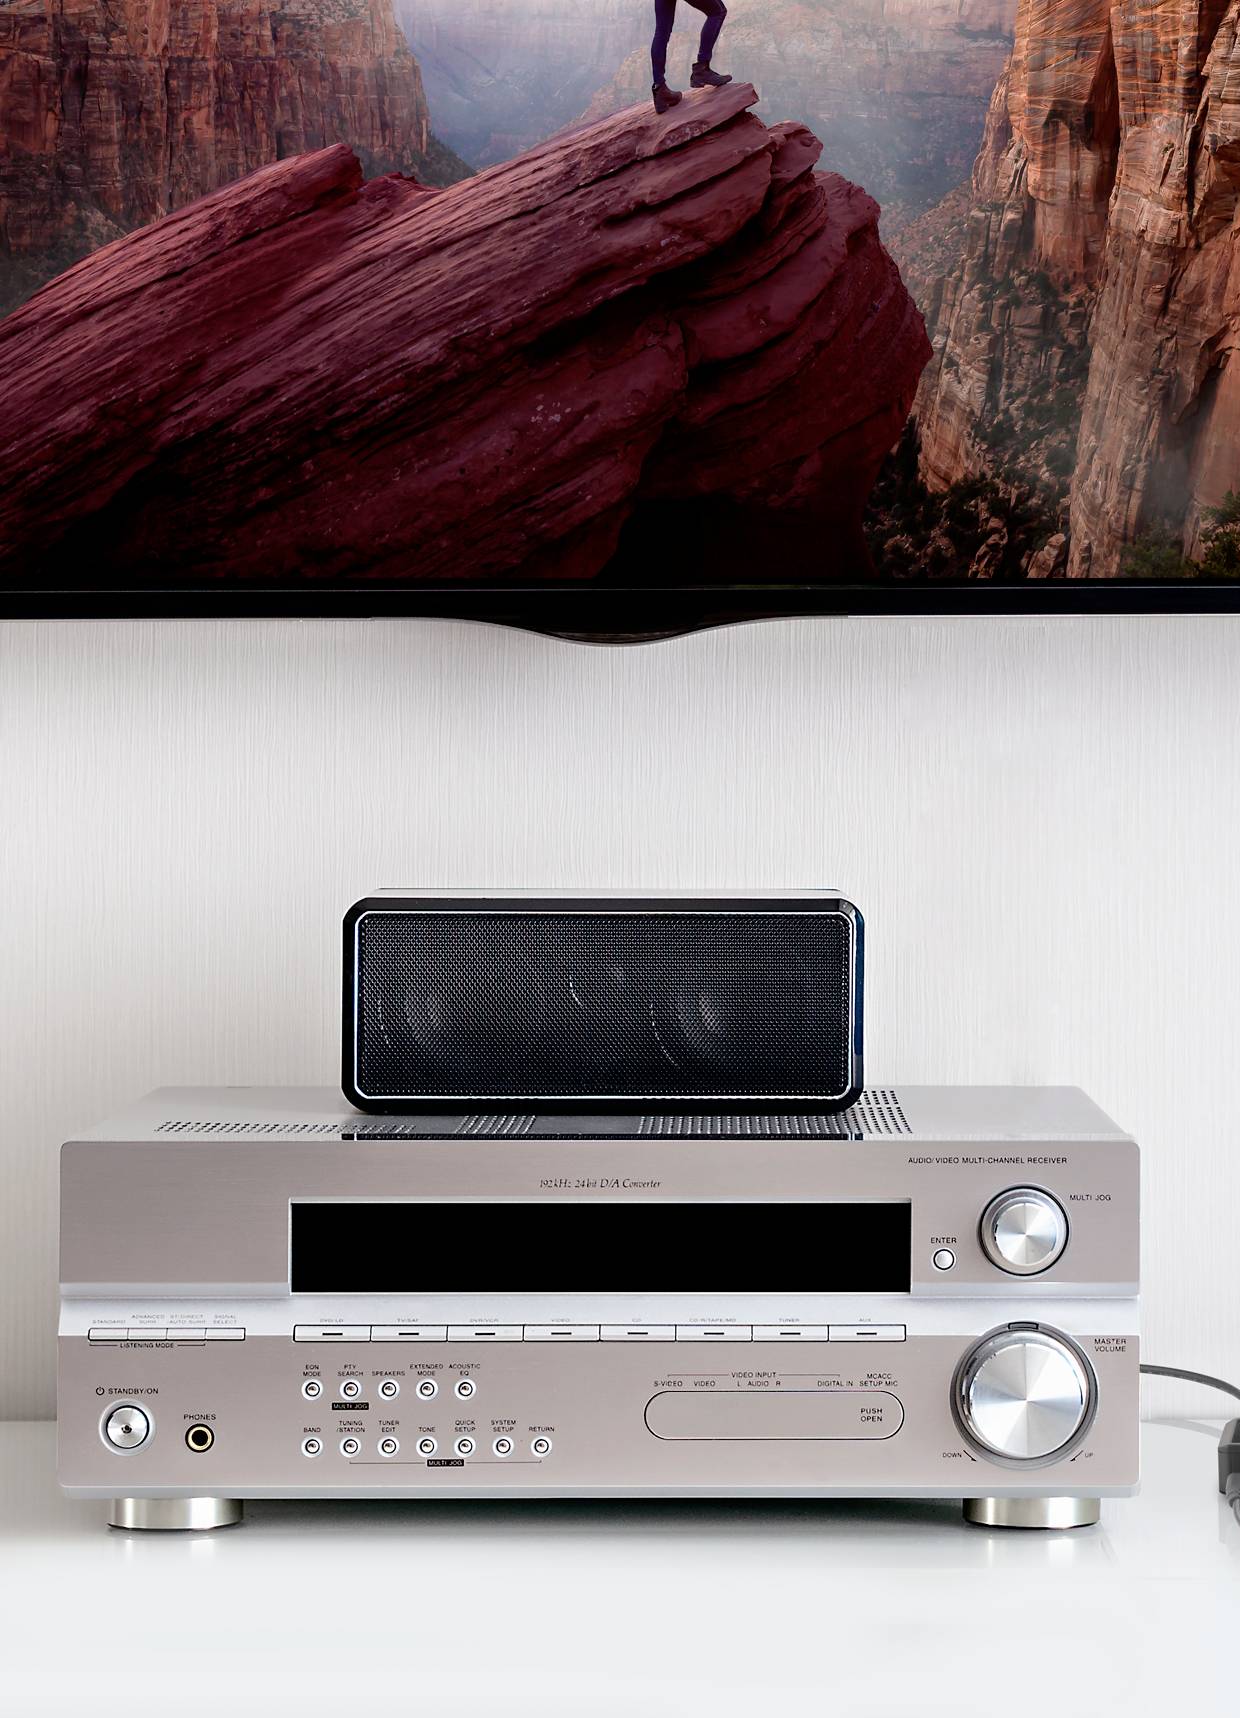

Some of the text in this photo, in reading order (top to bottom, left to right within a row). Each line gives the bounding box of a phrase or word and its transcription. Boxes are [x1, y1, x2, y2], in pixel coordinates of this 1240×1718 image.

[599, 1178, 620, 1188] D/A
[622, 1178, 661, 1188] Converter
[930, 1236, 957, 1244] ENTER
[108, 1387, 159, 1395] STANDBY/ON
[183, 1413, 217, 1421] PHONES
[454, 1419, 476, 1427] QUICK
